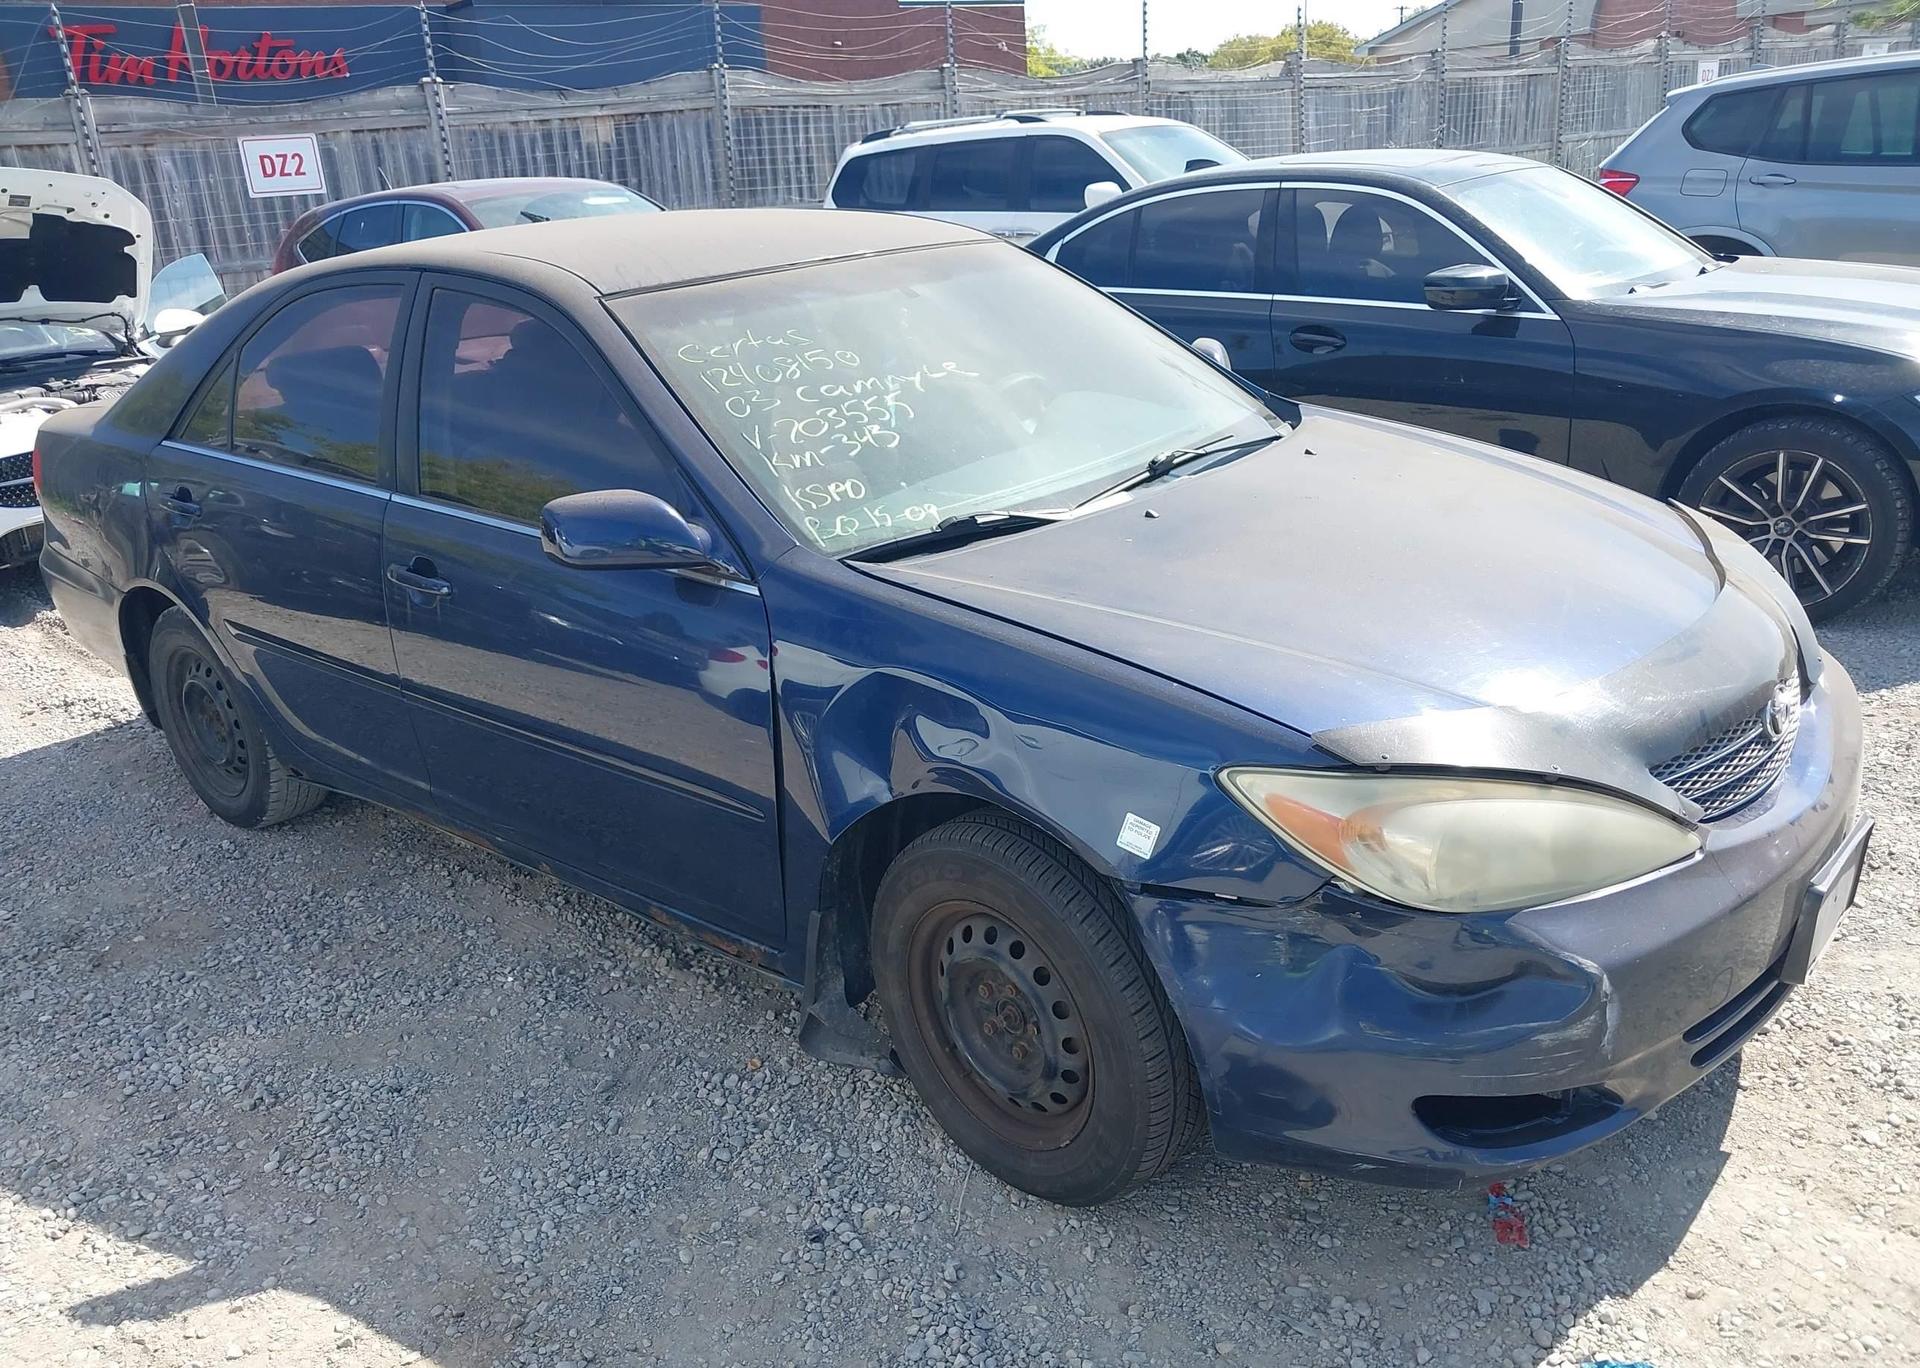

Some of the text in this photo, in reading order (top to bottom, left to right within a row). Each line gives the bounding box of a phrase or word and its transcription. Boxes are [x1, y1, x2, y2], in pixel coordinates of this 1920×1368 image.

[48, 21, 350, 86] Tim Hortons
[258, 152, 307, 179] DZ2
